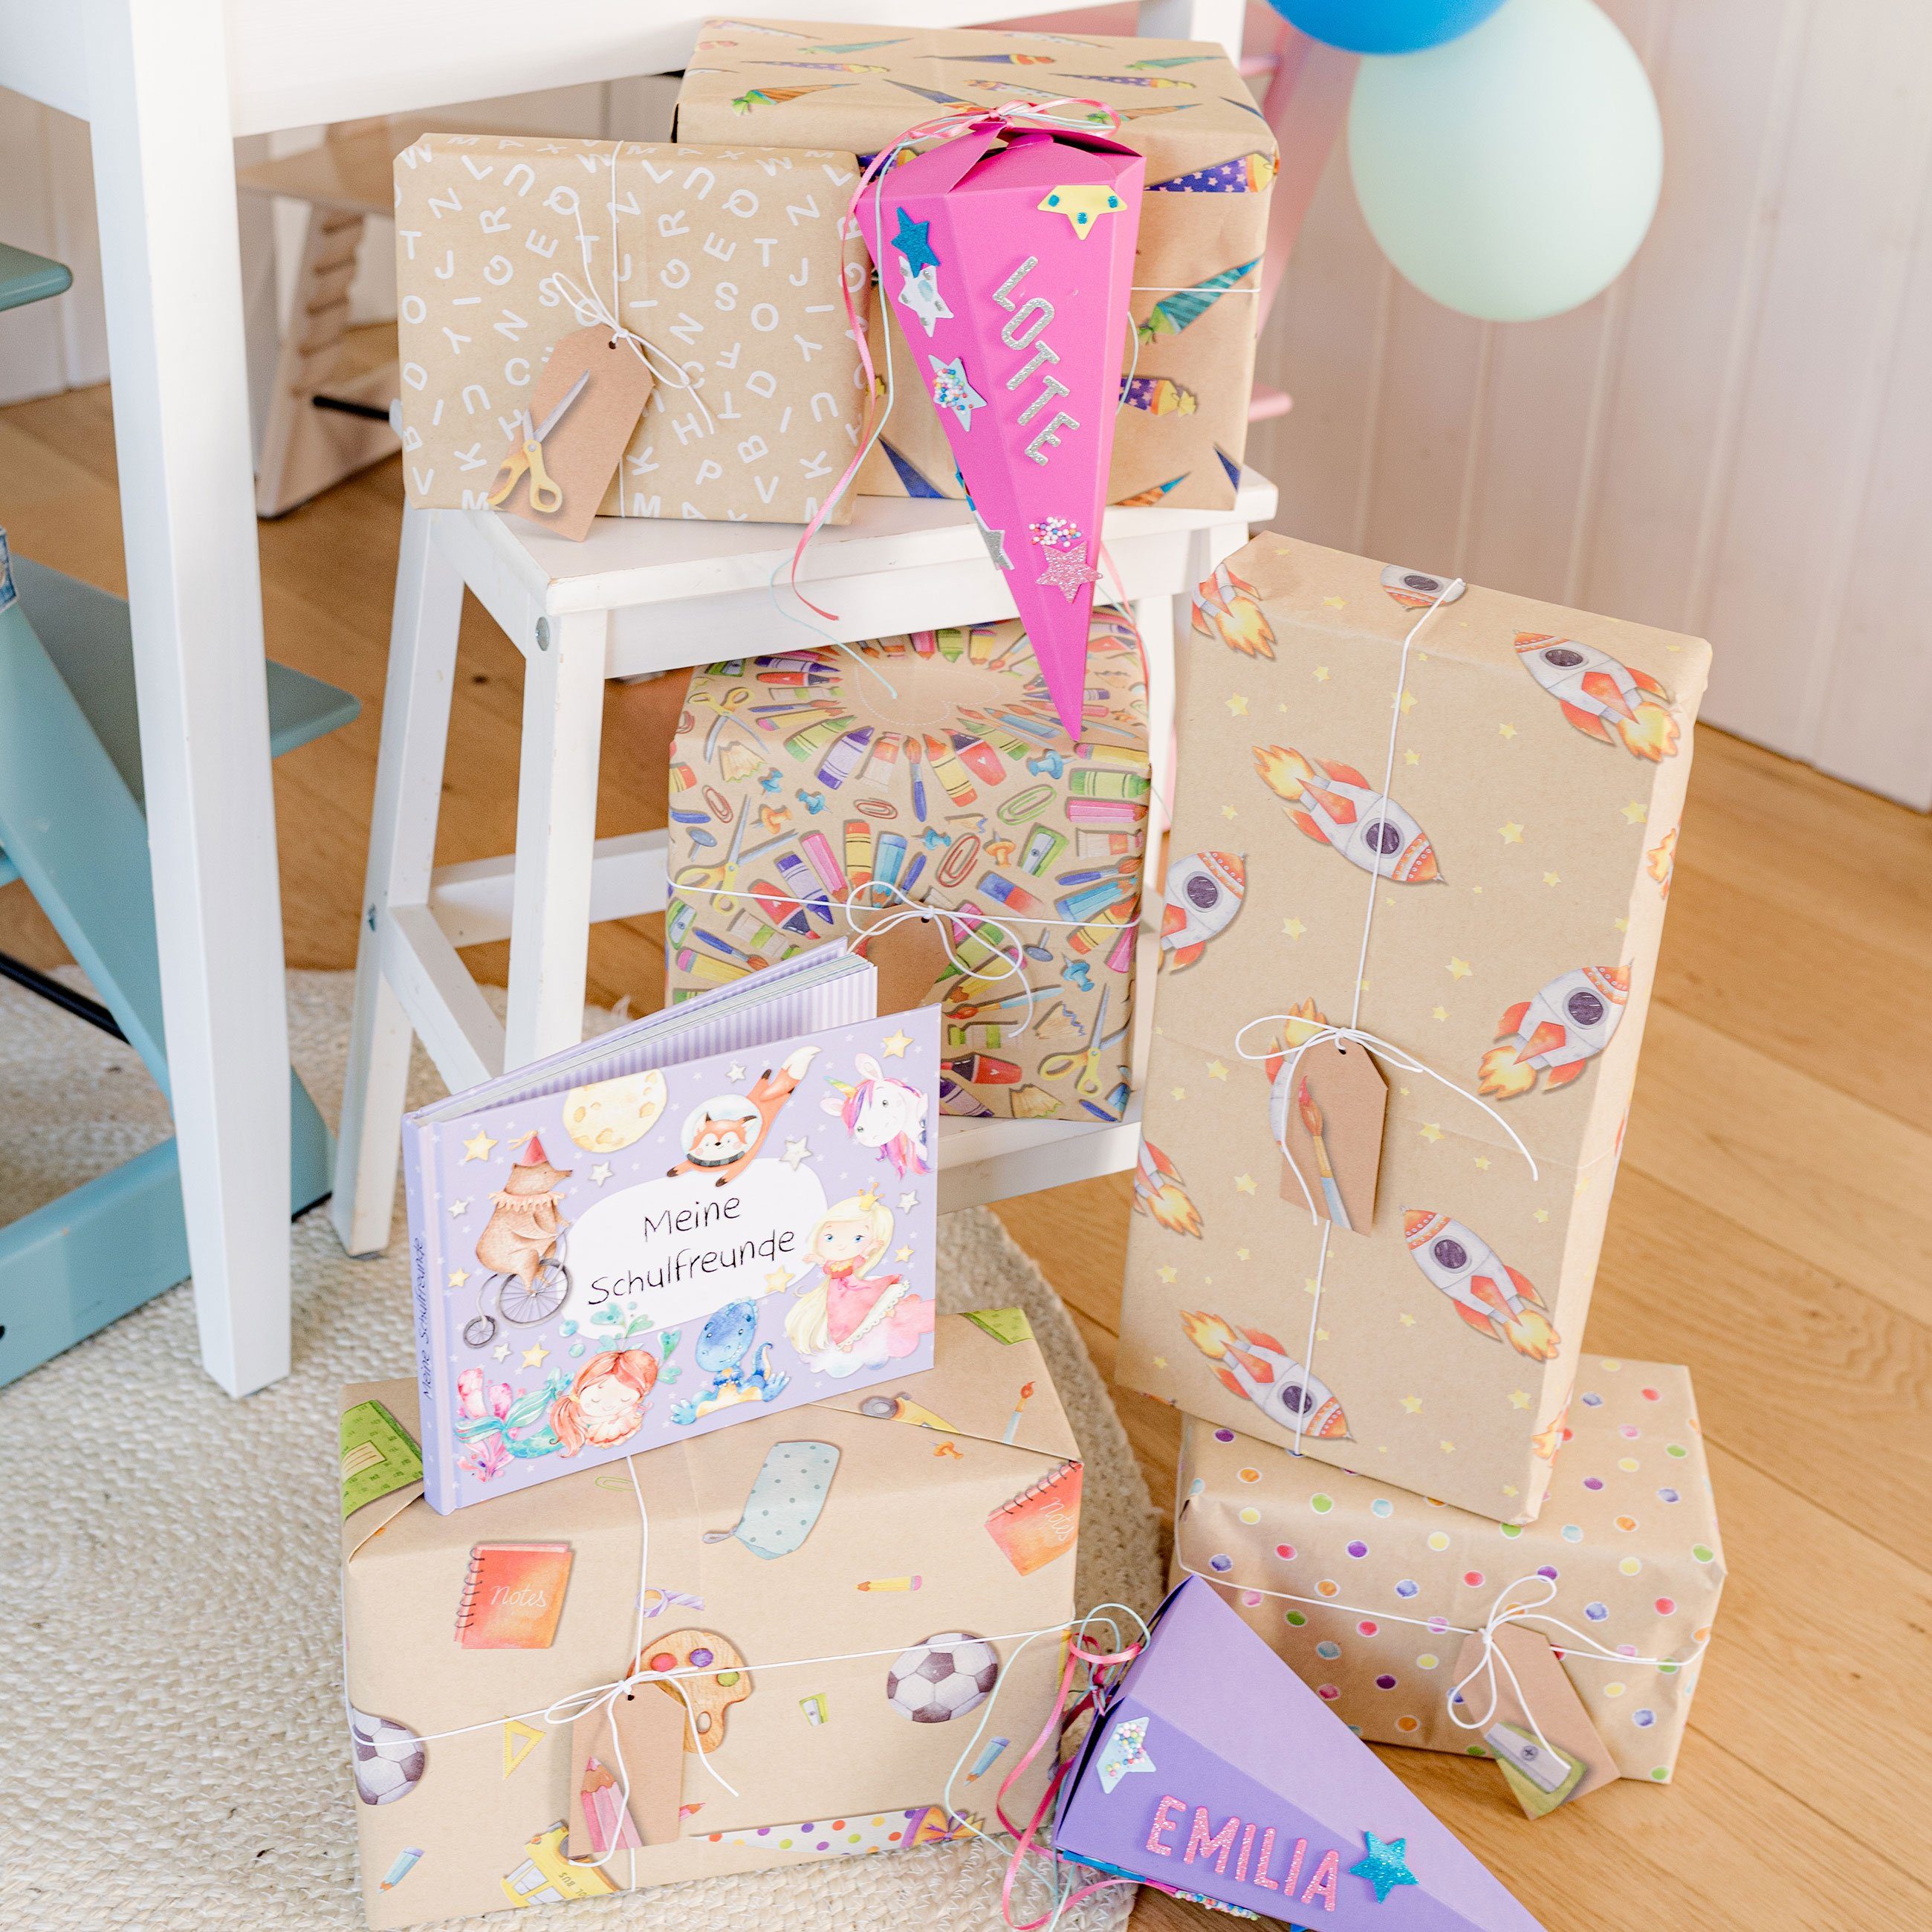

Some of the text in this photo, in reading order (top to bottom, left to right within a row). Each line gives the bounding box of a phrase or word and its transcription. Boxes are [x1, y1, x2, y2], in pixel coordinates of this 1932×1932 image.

[461, 155, 493, 181] L
[641, 159, 675, 184] L
[722, 188, 759, 218] Q
[479, 206, 511, 234] R
[658, 210, 690, 238] R
[400, 230, 423, 260] T
[525, 228, 559, 259] E
[702, 233, 737, 262] E
[753, 238, 779, 268] T
[434, 250, 454, 280] J
[788, 258, 809, 287] J
[401, 294, 427, 325] O
[715, 282, 739, 312] S
[750, 302, 779, 333] O
[442, 326, 472, 355] Y
[793, 334, 823, 363] Y
[505, 357, 531, 386] C
[992, 256, 1080, 466] LOTTE
[672, 412, 705, 446] H
[453, 442, 488, 472] K
[737, 435, 769, 464] B
[695, 459, 723, 486] P
[799, 450, 833, 479] K
[412, 467, 435, 496] V
[753, 476, 779, 505] V
[644, 1197, 741, 1242] Meine
[588, 1229, 795, 1305] Schulfreunde
[414, 1237, 433, 1400] Meine Schulfreunde
[1146, 1794, 1339, 1913] EMILIA
[558, 1872, 576, 1887] BUS
